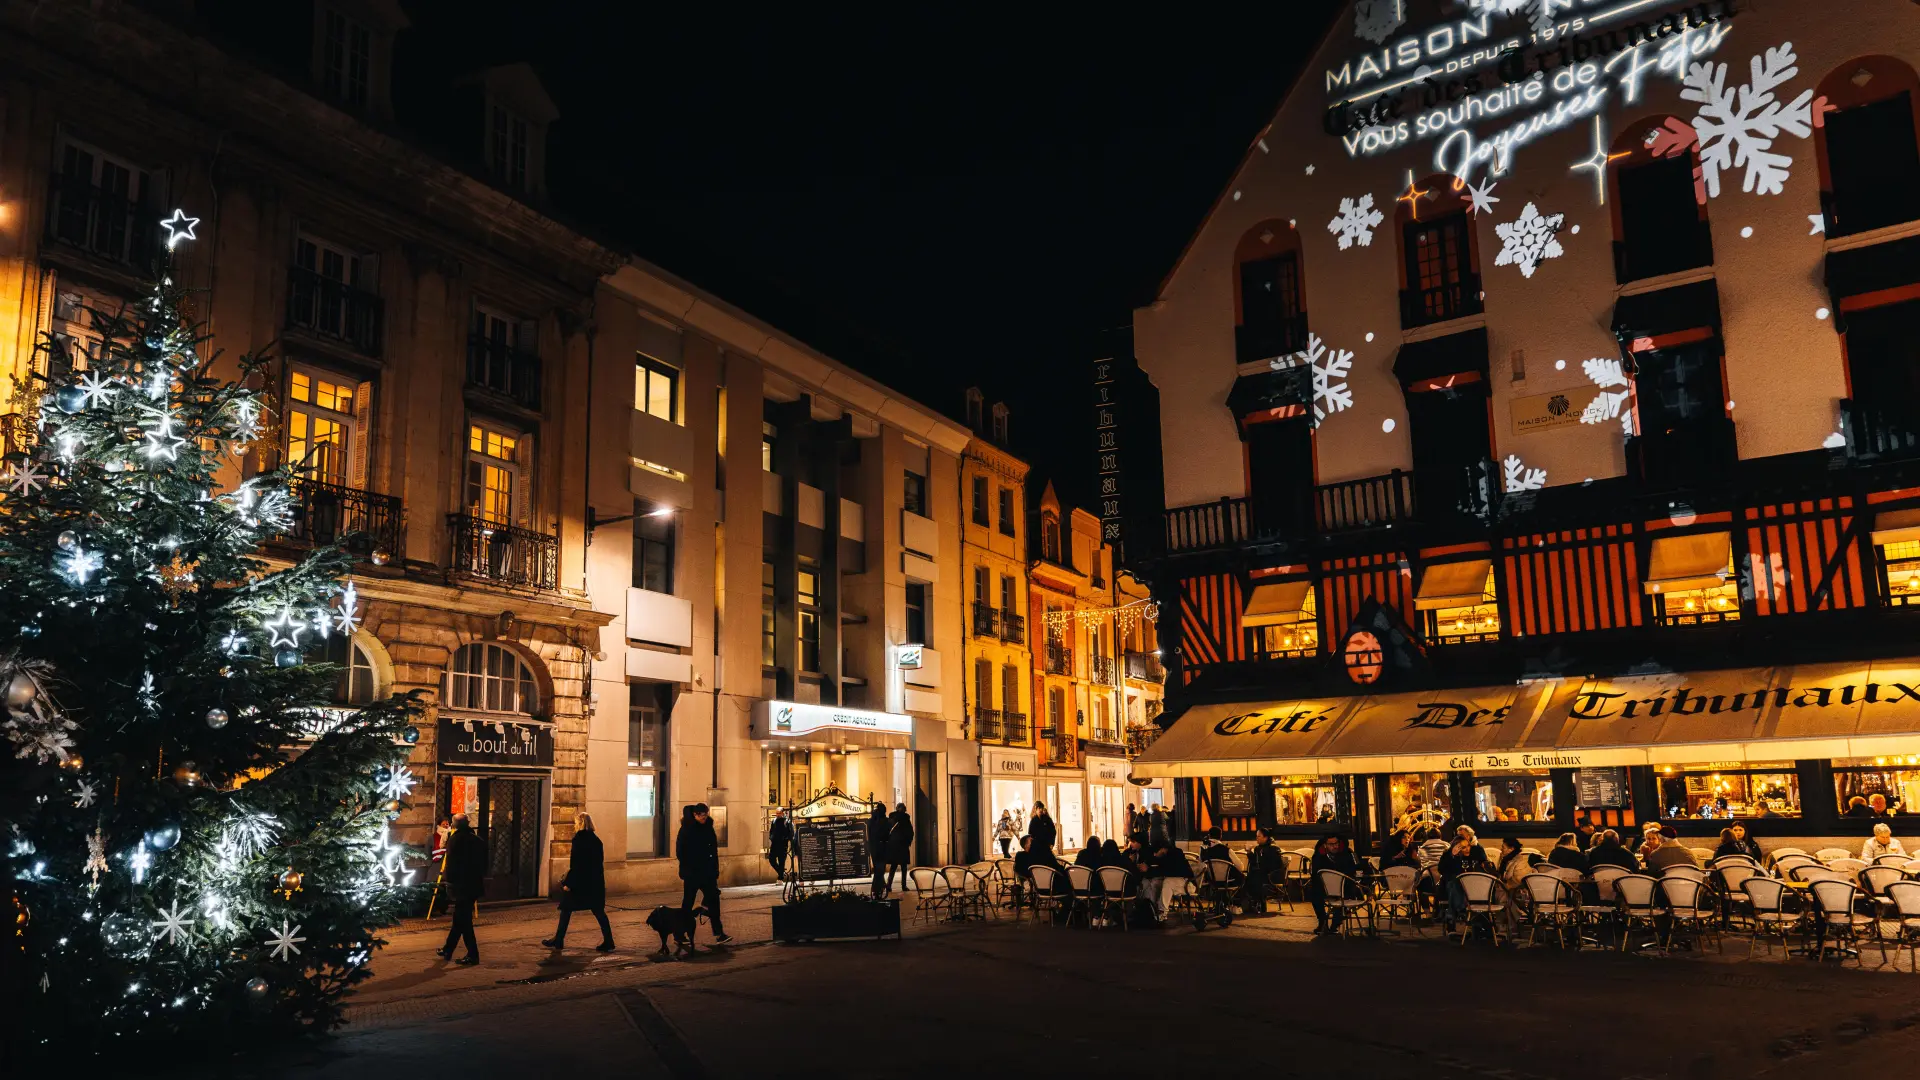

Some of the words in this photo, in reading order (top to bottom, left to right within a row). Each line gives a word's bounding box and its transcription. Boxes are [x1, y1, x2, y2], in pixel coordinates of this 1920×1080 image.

[1325, 15, 1489, 92] MAISON
[1446, 39, 1520, 73] DEPUIS
[1530, 17, 1585, 44] 1975
[1342, 121, 1410, 156] Vous
[1416, 80, 1544, 136] souhaite
[1553, 62, 1598, 92] de
[1438, 83, 1608, 190] Joyeuses
[1604, 17, 1733, 102] Fêtes
[1517, 415, 1555, 426] MAISON
[1213, 706, 1338, 736] Café
[1397, 702, 1512, 732] Des
[1569, 683, 1920, 720] Tribunaux
[457, 743, 470, 752] au
[473, 732, 508, 753] bout
[510, 742, 522, 755] du
[524, 734, 537, 756] fil
[1449, 755, 1473, 769] Café
[1486, 755, 1510, 767] Des
[1522, 754, 1582, 767] Tribunaux
